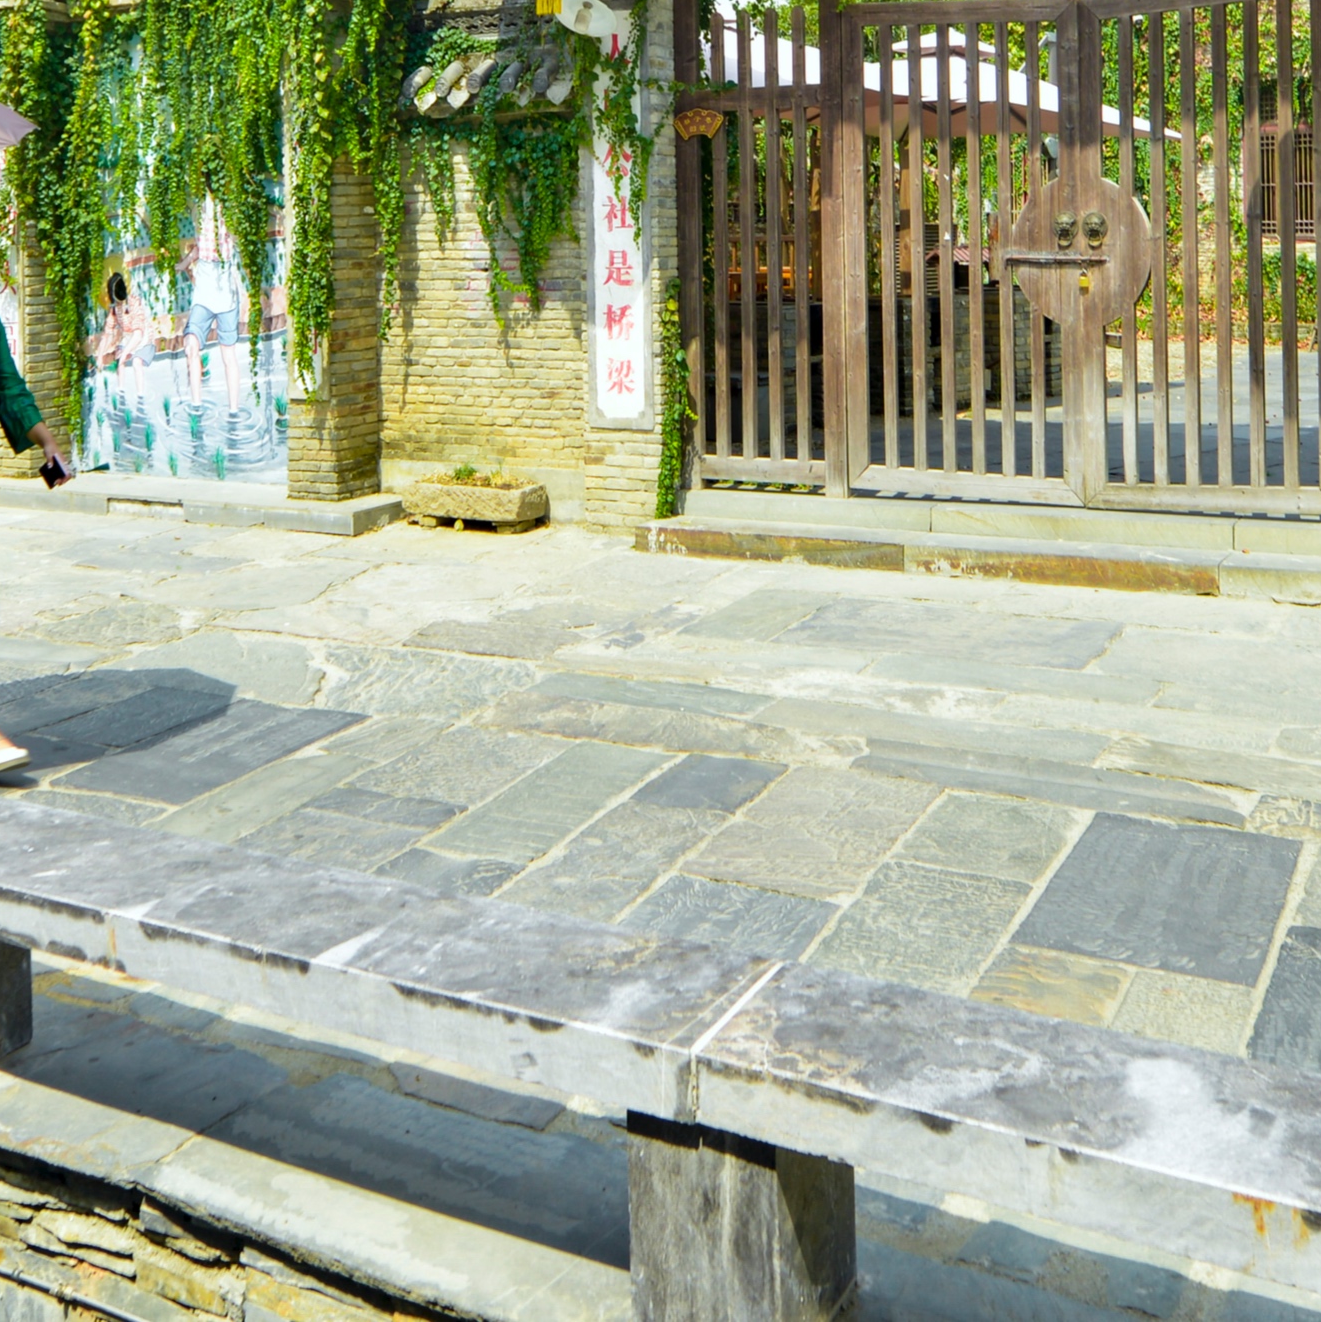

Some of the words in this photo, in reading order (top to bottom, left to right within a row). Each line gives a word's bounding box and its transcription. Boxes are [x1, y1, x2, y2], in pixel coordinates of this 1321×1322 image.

[601, 33, 635, 395] 人公社是桥梁
